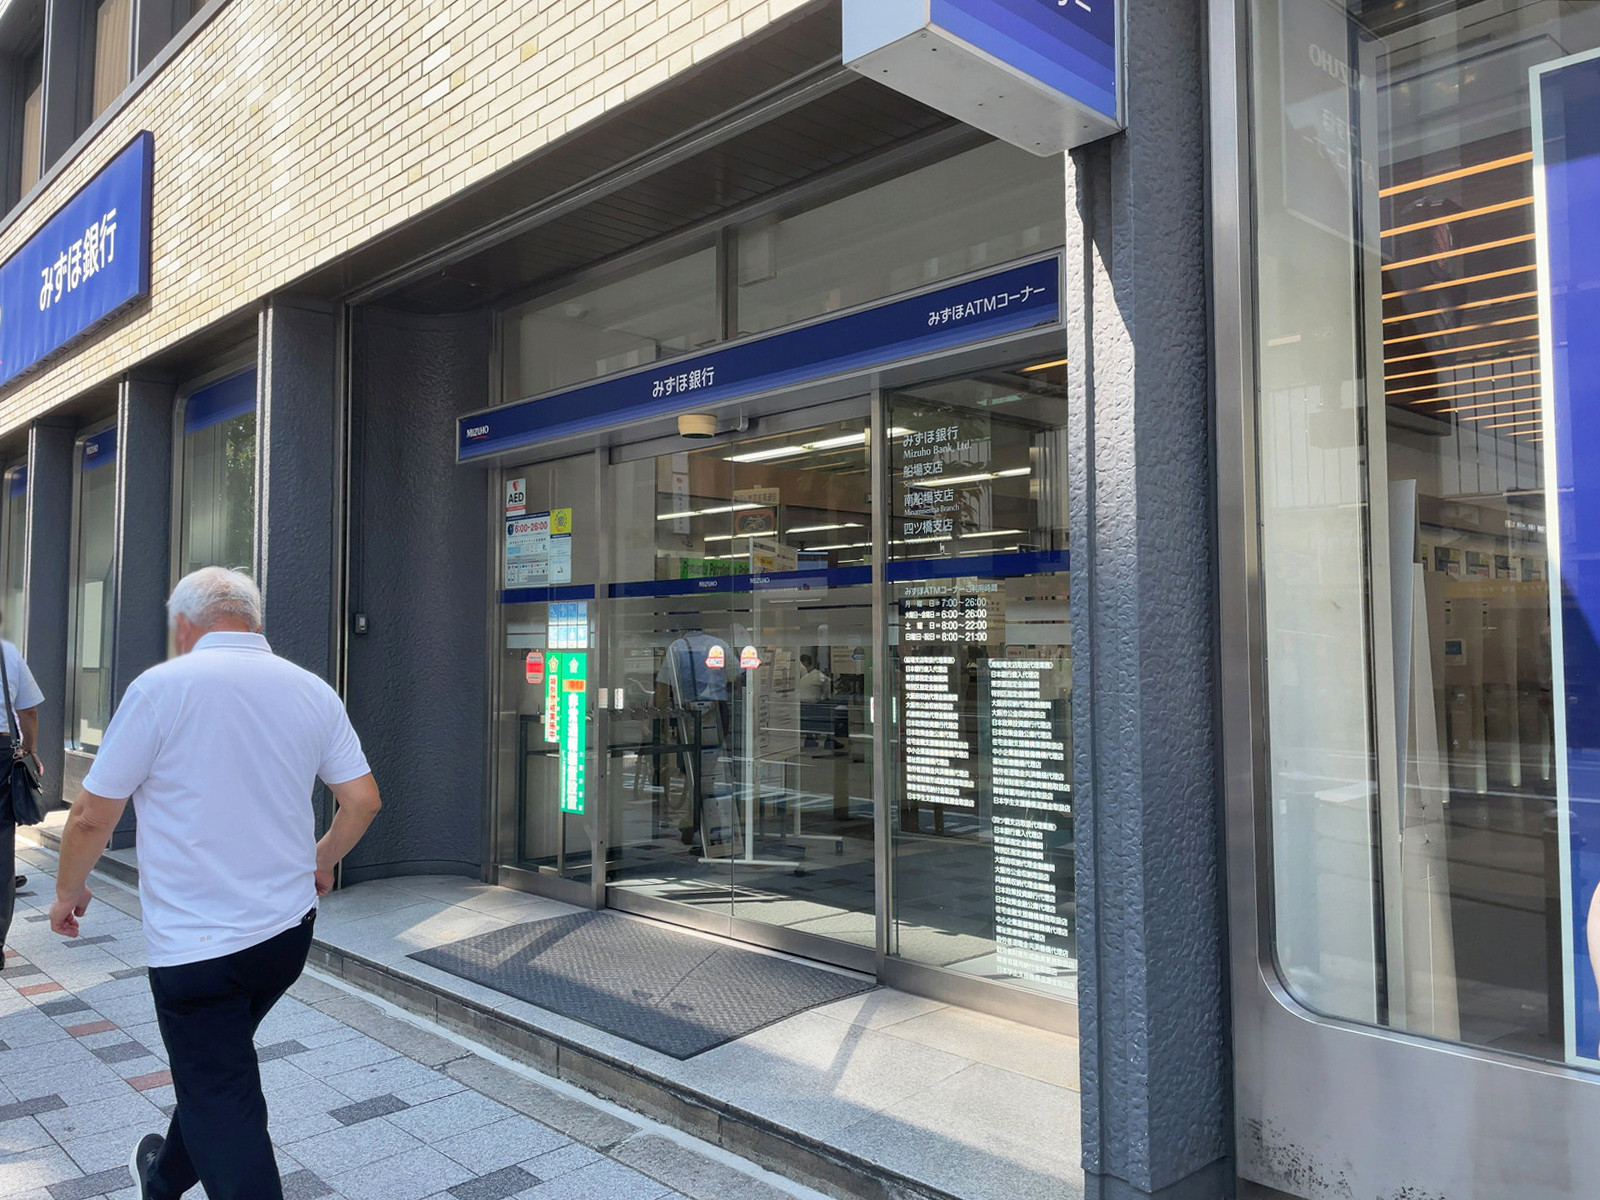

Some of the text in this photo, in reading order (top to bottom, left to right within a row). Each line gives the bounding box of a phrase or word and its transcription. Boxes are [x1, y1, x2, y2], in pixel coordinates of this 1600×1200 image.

[39, 207, 117, 312] みずほ銀行
[927, 285, 1046, 326] みずほATMコーナー
[652, 366, 715, 398] みずほ銀行
[466, 425, 490, 438] MIZUHO
[902, 426, 959, 448] みずほ銀行
[903, 448, 930, 459] Mizuho
[902, 460, 943, 477] 船場支店
[508, 492, 524, 504] AED
[904, 488, 954, 506] 南船場支店
[904, 518, 953, 534] 四ツ橋支店
